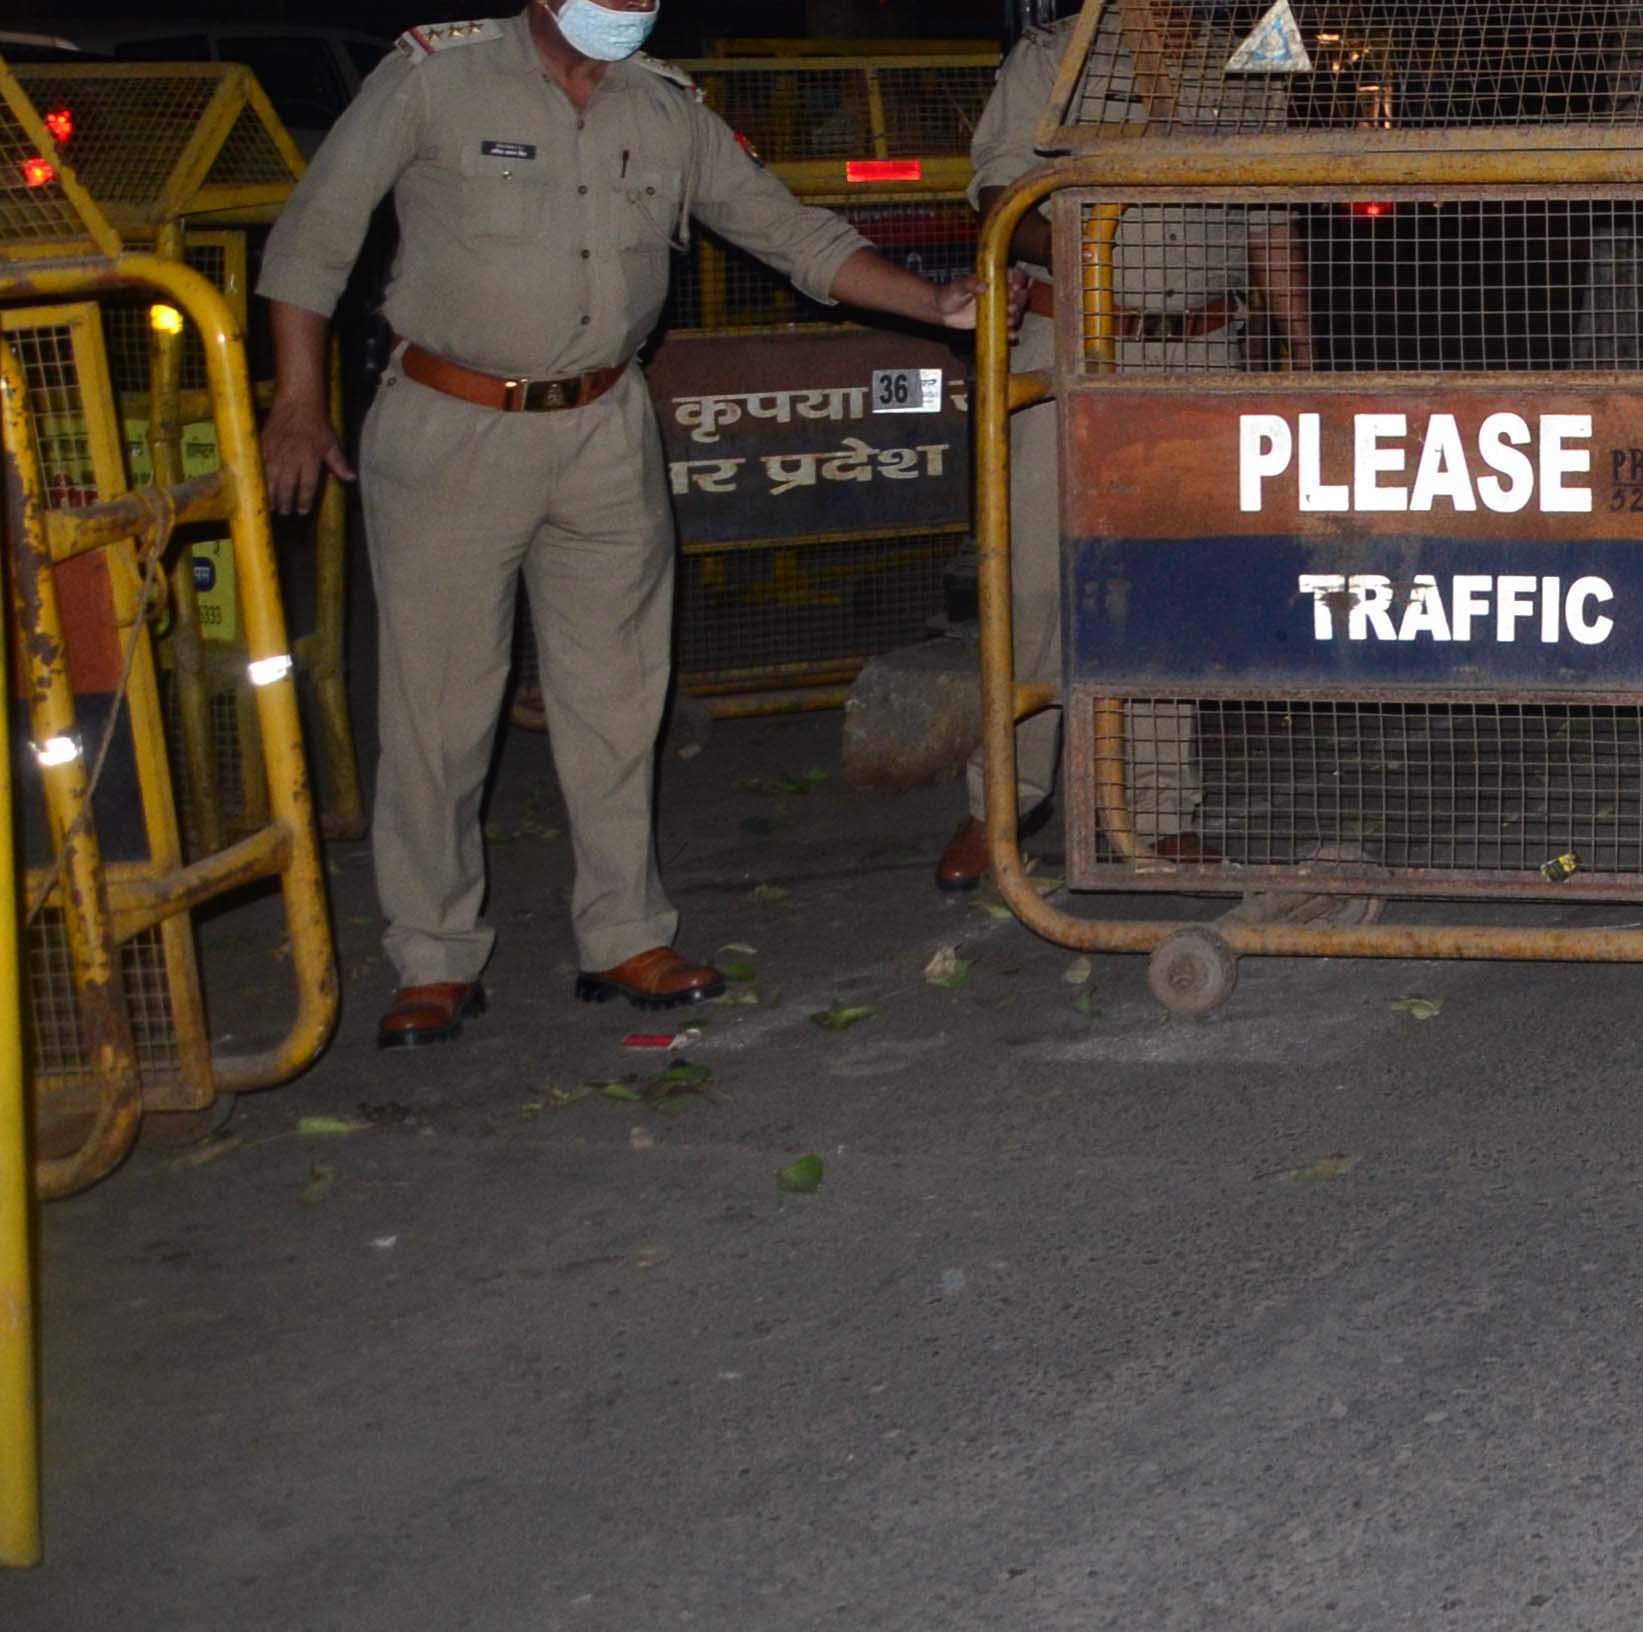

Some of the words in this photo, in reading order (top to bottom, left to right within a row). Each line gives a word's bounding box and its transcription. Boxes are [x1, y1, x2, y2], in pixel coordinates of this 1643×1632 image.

[672, 386, 869, 443] कृपया
[879, 374, 908, 404] 36
[760, 437, 950, 496] प्रदेश
[1238, 412, 1593, 514] PLEASE
[1297, 574, 1614, 645] TRAFFIC
